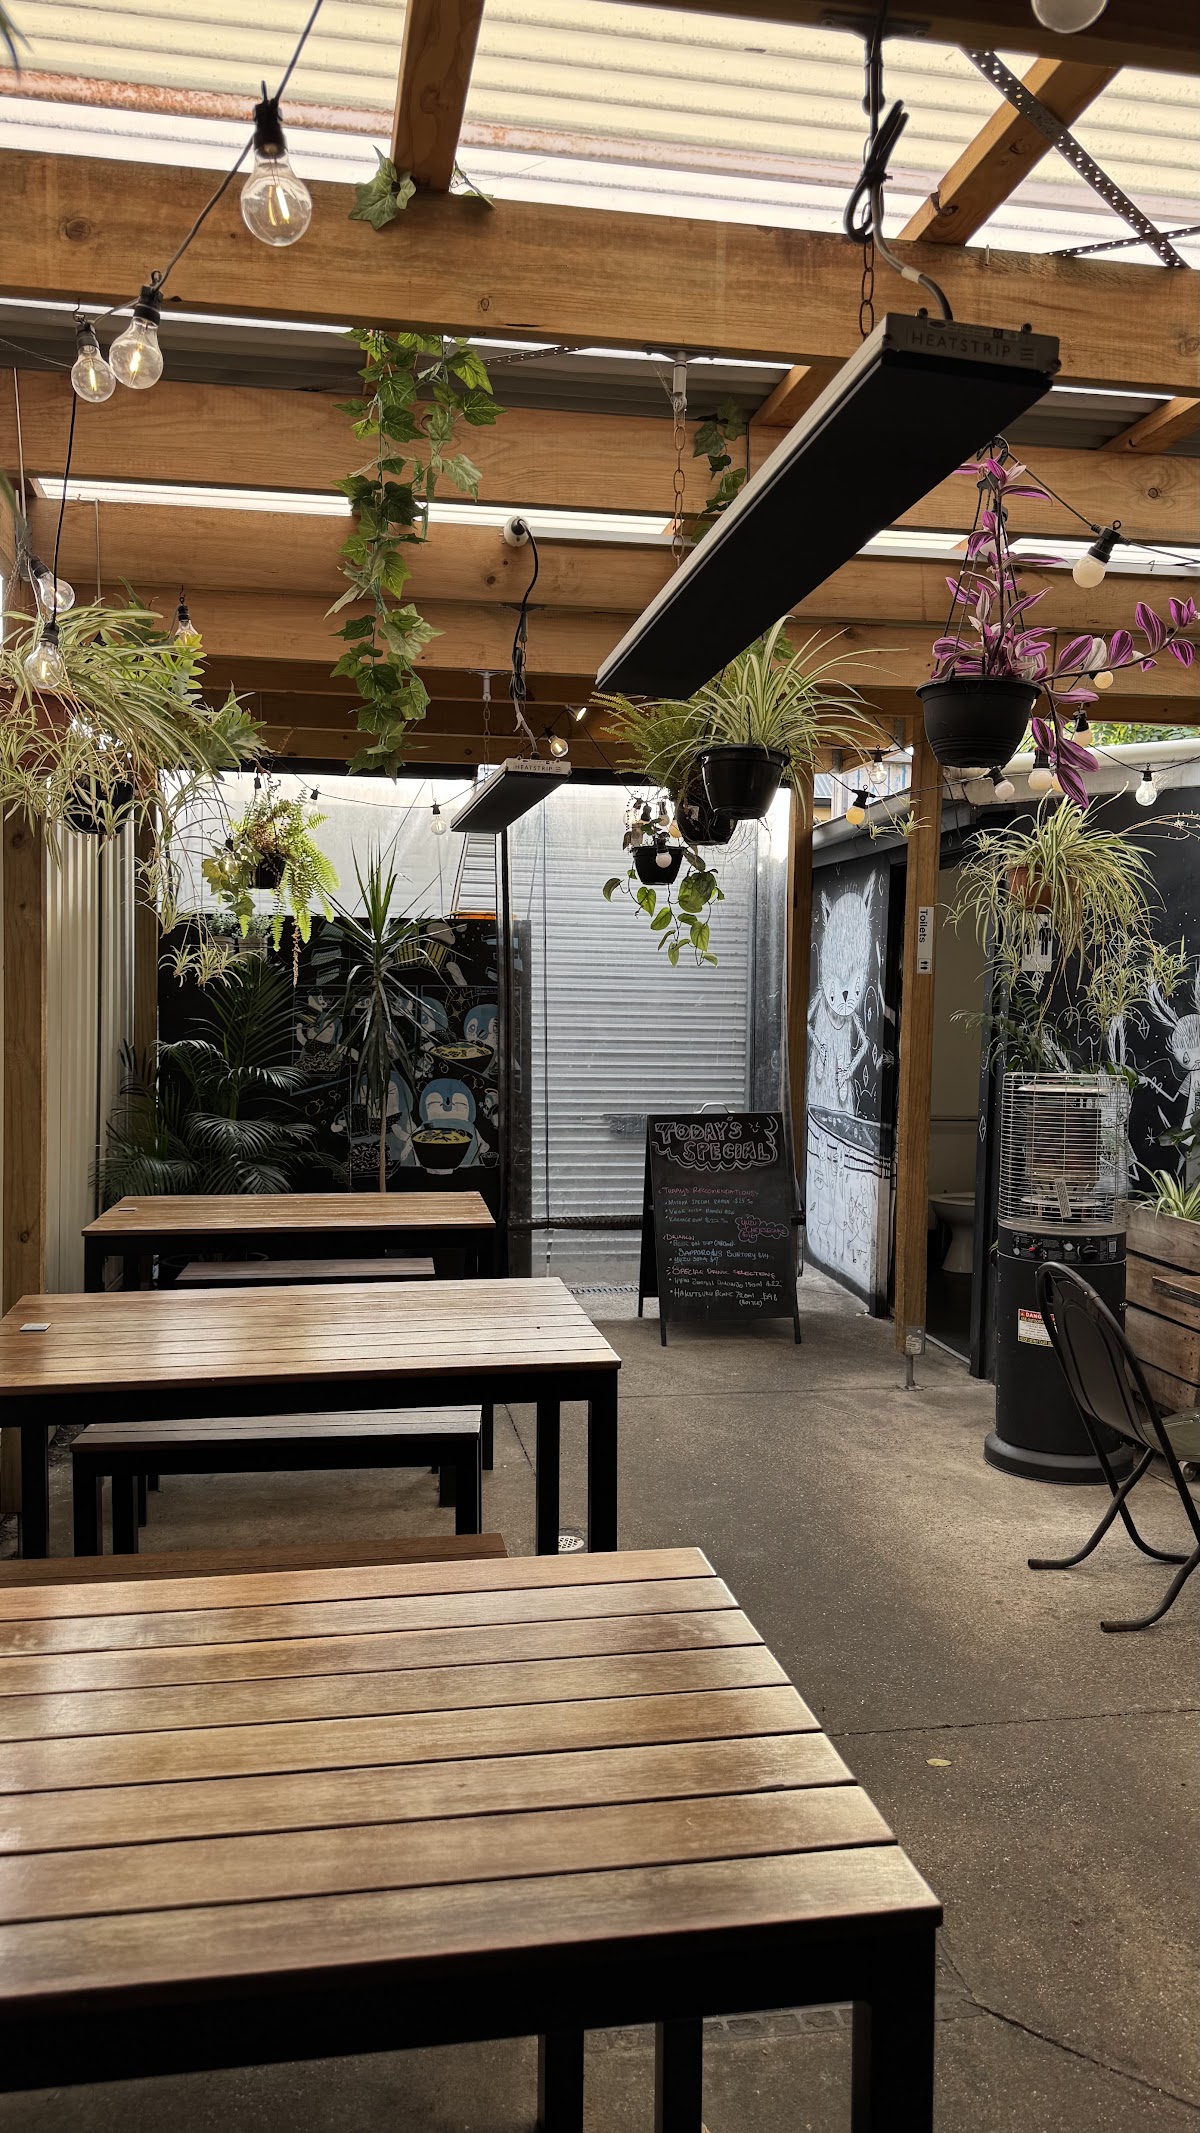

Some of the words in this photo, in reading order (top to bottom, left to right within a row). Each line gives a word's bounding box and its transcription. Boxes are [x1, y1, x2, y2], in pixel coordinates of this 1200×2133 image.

[911, 331, 1011, 358] HEATSTRIP
[514, 764, 553, 772] HEATSTRIP
[919, 909, 928, 943] Toilets
[655, 1116, 743, 1145] TODAY'S
[682, 1141, 771, 1161] SPECIAL
[678, 1247, 710, 1257] SAPPORO
